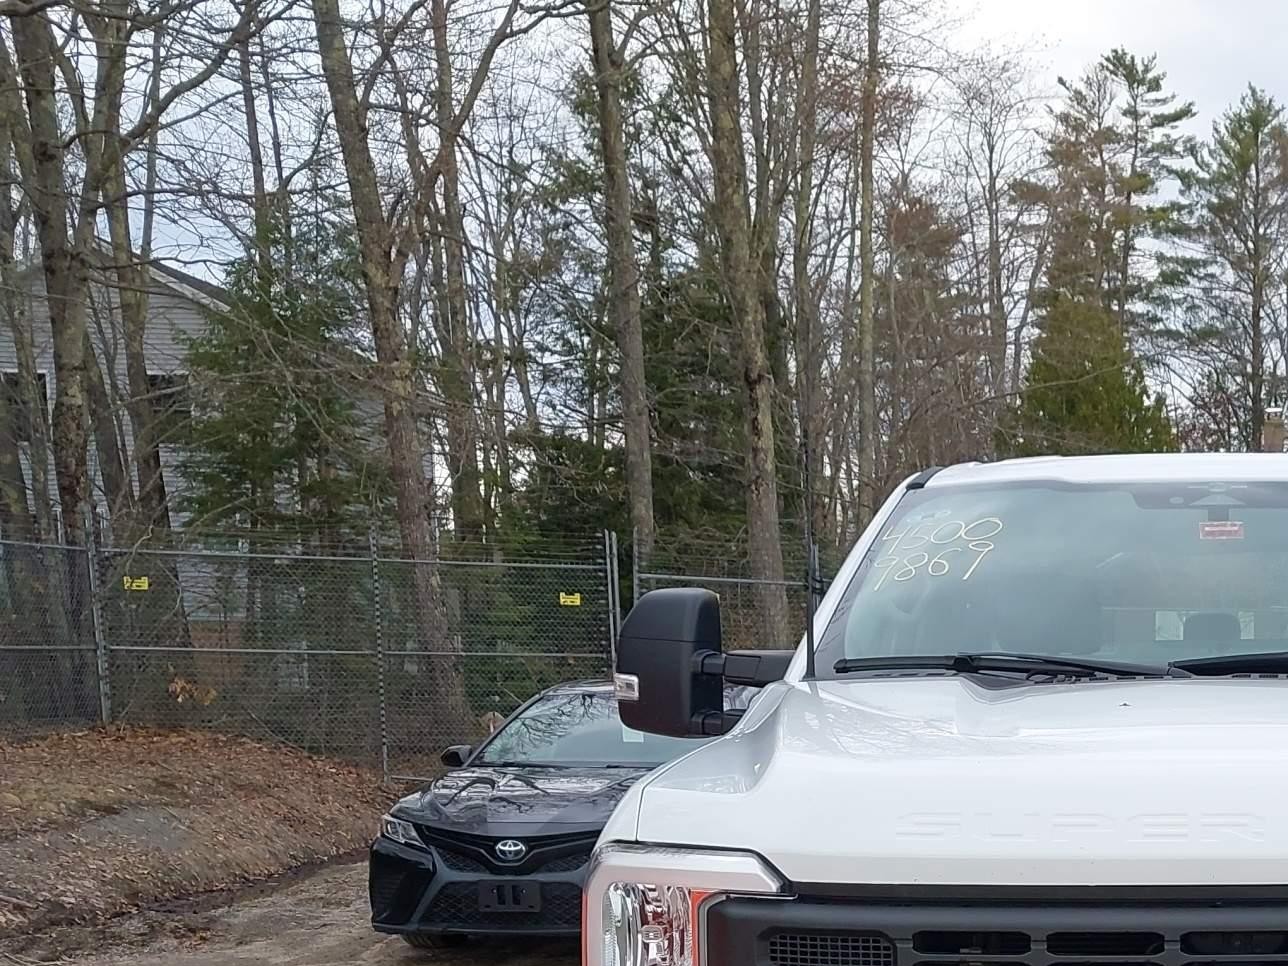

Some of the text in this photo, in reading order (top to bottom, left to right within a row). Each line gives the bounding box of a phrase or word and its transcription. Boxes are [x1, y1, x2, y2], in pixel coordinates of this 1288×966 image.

[882, 517, 1003, 555] 4500
[874, 540, 994, 592] 9869
[895, 811, 1264, 841] SUPER
